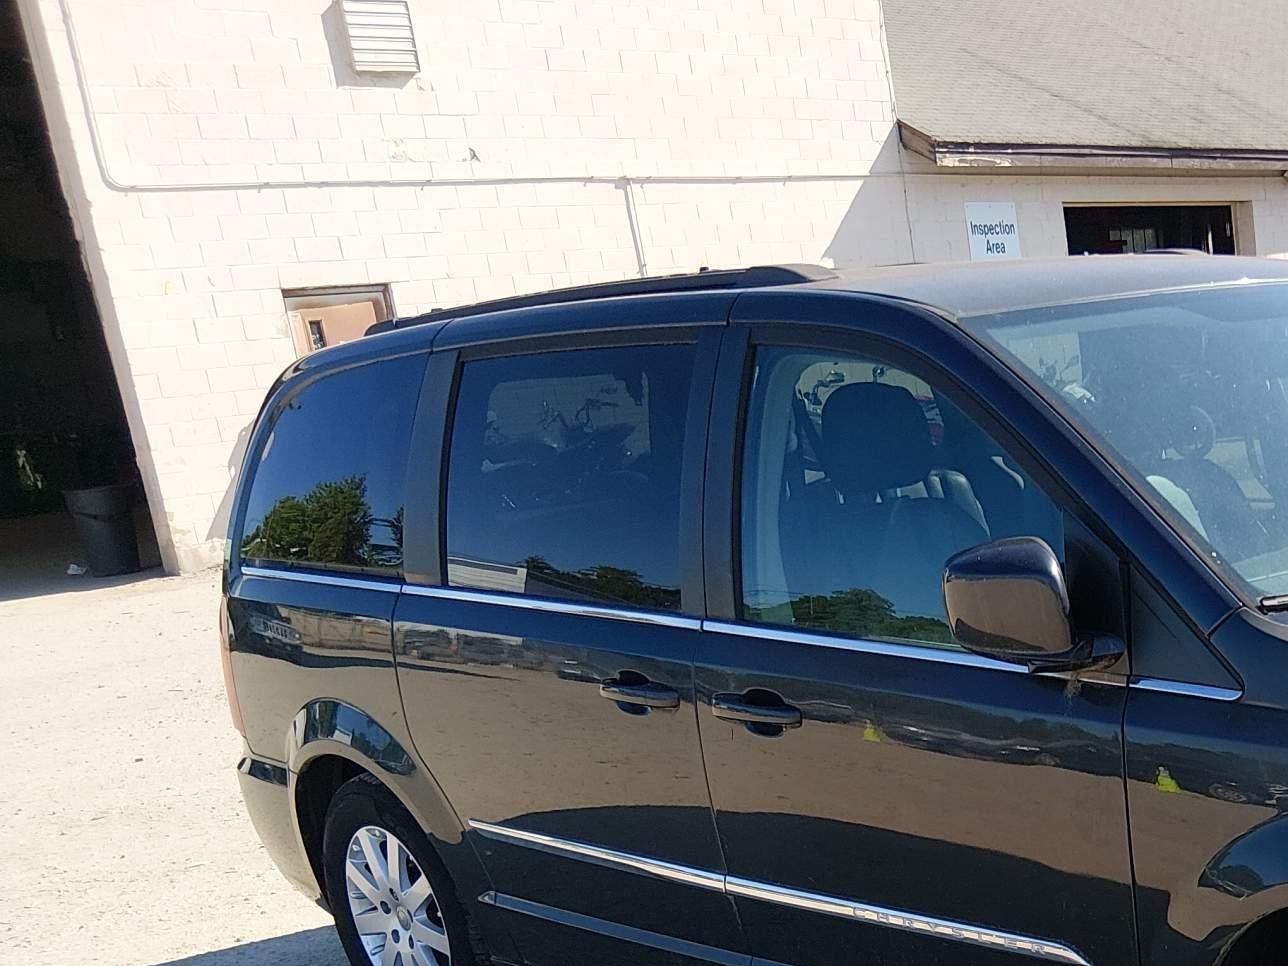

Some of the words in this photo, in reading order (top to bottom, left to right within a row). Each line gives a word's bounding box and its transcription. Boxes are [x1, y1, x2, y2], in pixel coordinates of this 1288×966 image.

[970, 219, 1015, 238] Inspection
[986, 239, 1006, 255] Area
[853, 906, 1047, 954] CHRYSLER
